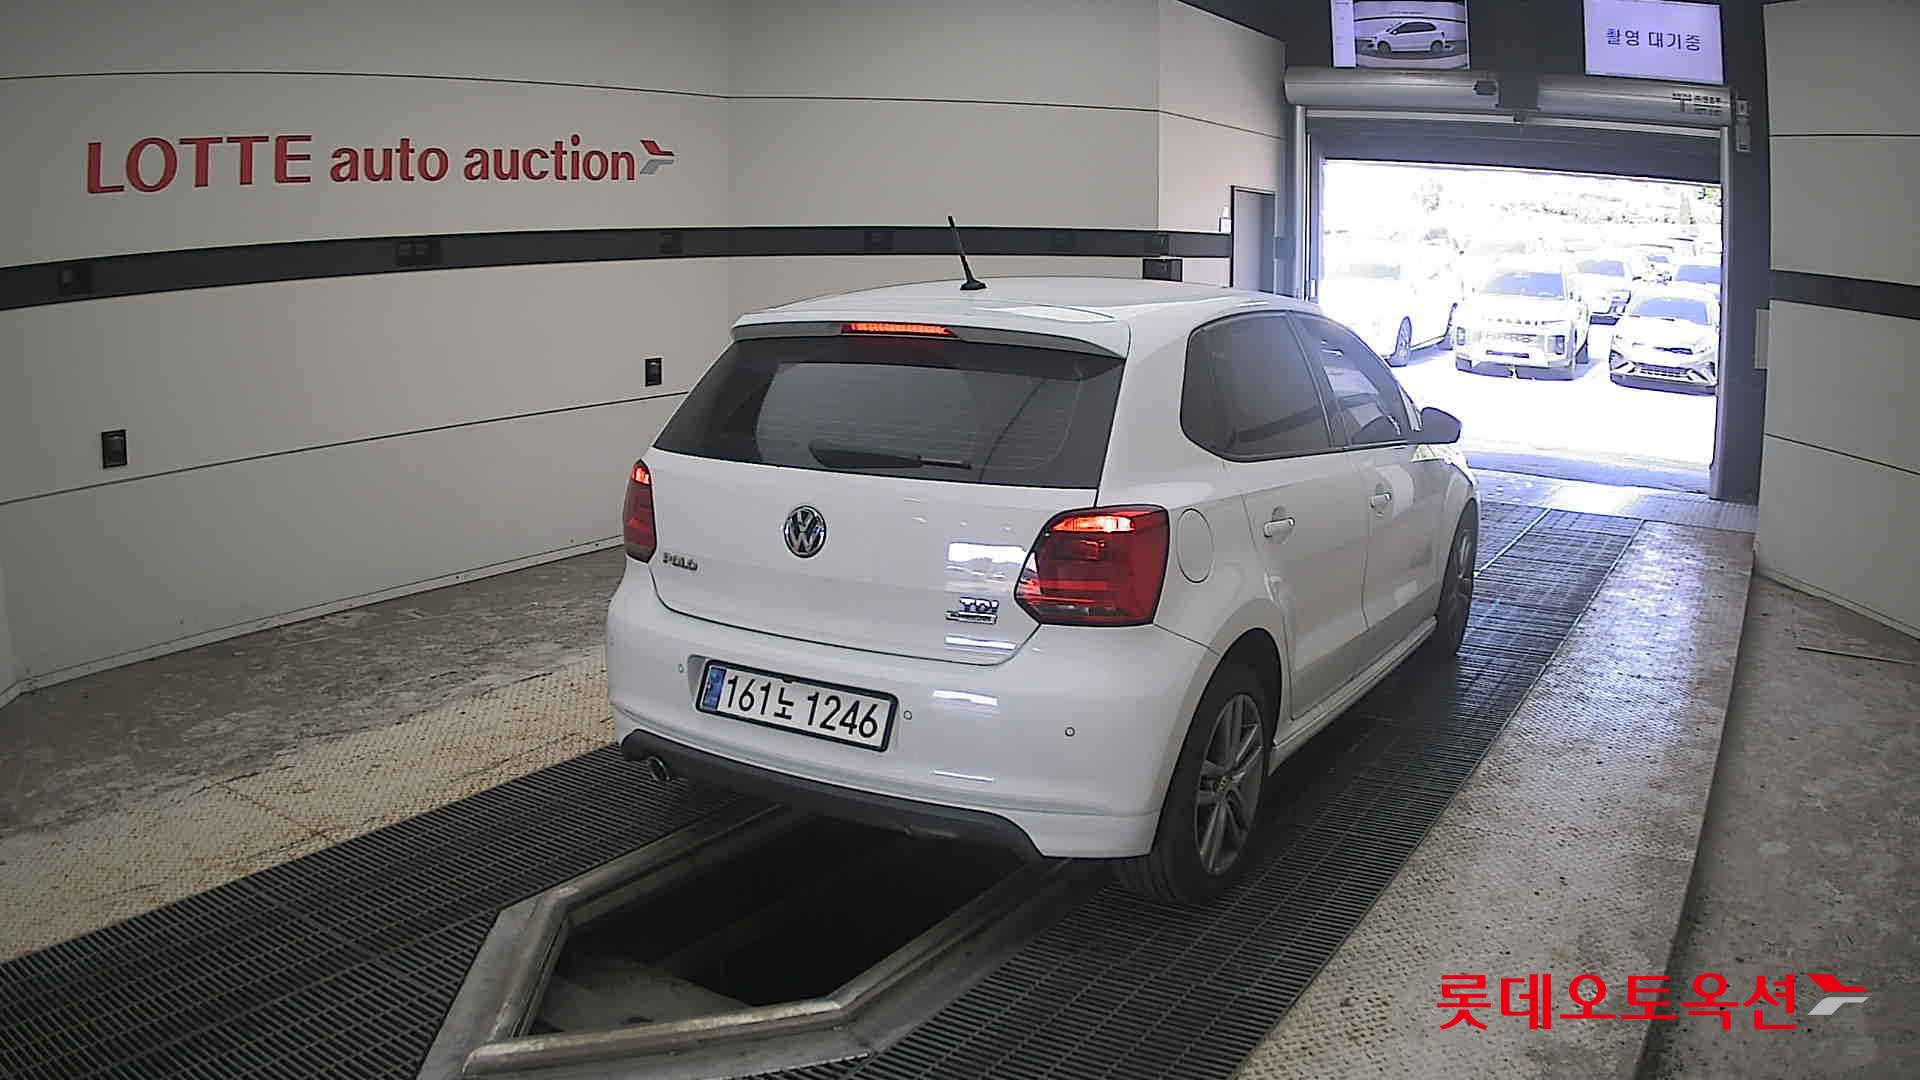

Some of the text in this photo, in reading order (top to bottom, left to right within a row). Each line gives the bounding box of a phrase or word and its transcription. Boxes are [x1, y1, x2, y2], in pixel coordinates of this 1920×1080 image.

[1648, 31, 1703, 51] 대기중
[87, 134, 636, 194] LOTTE auto auction
[726, 675, 878, 738] 161노 1246
